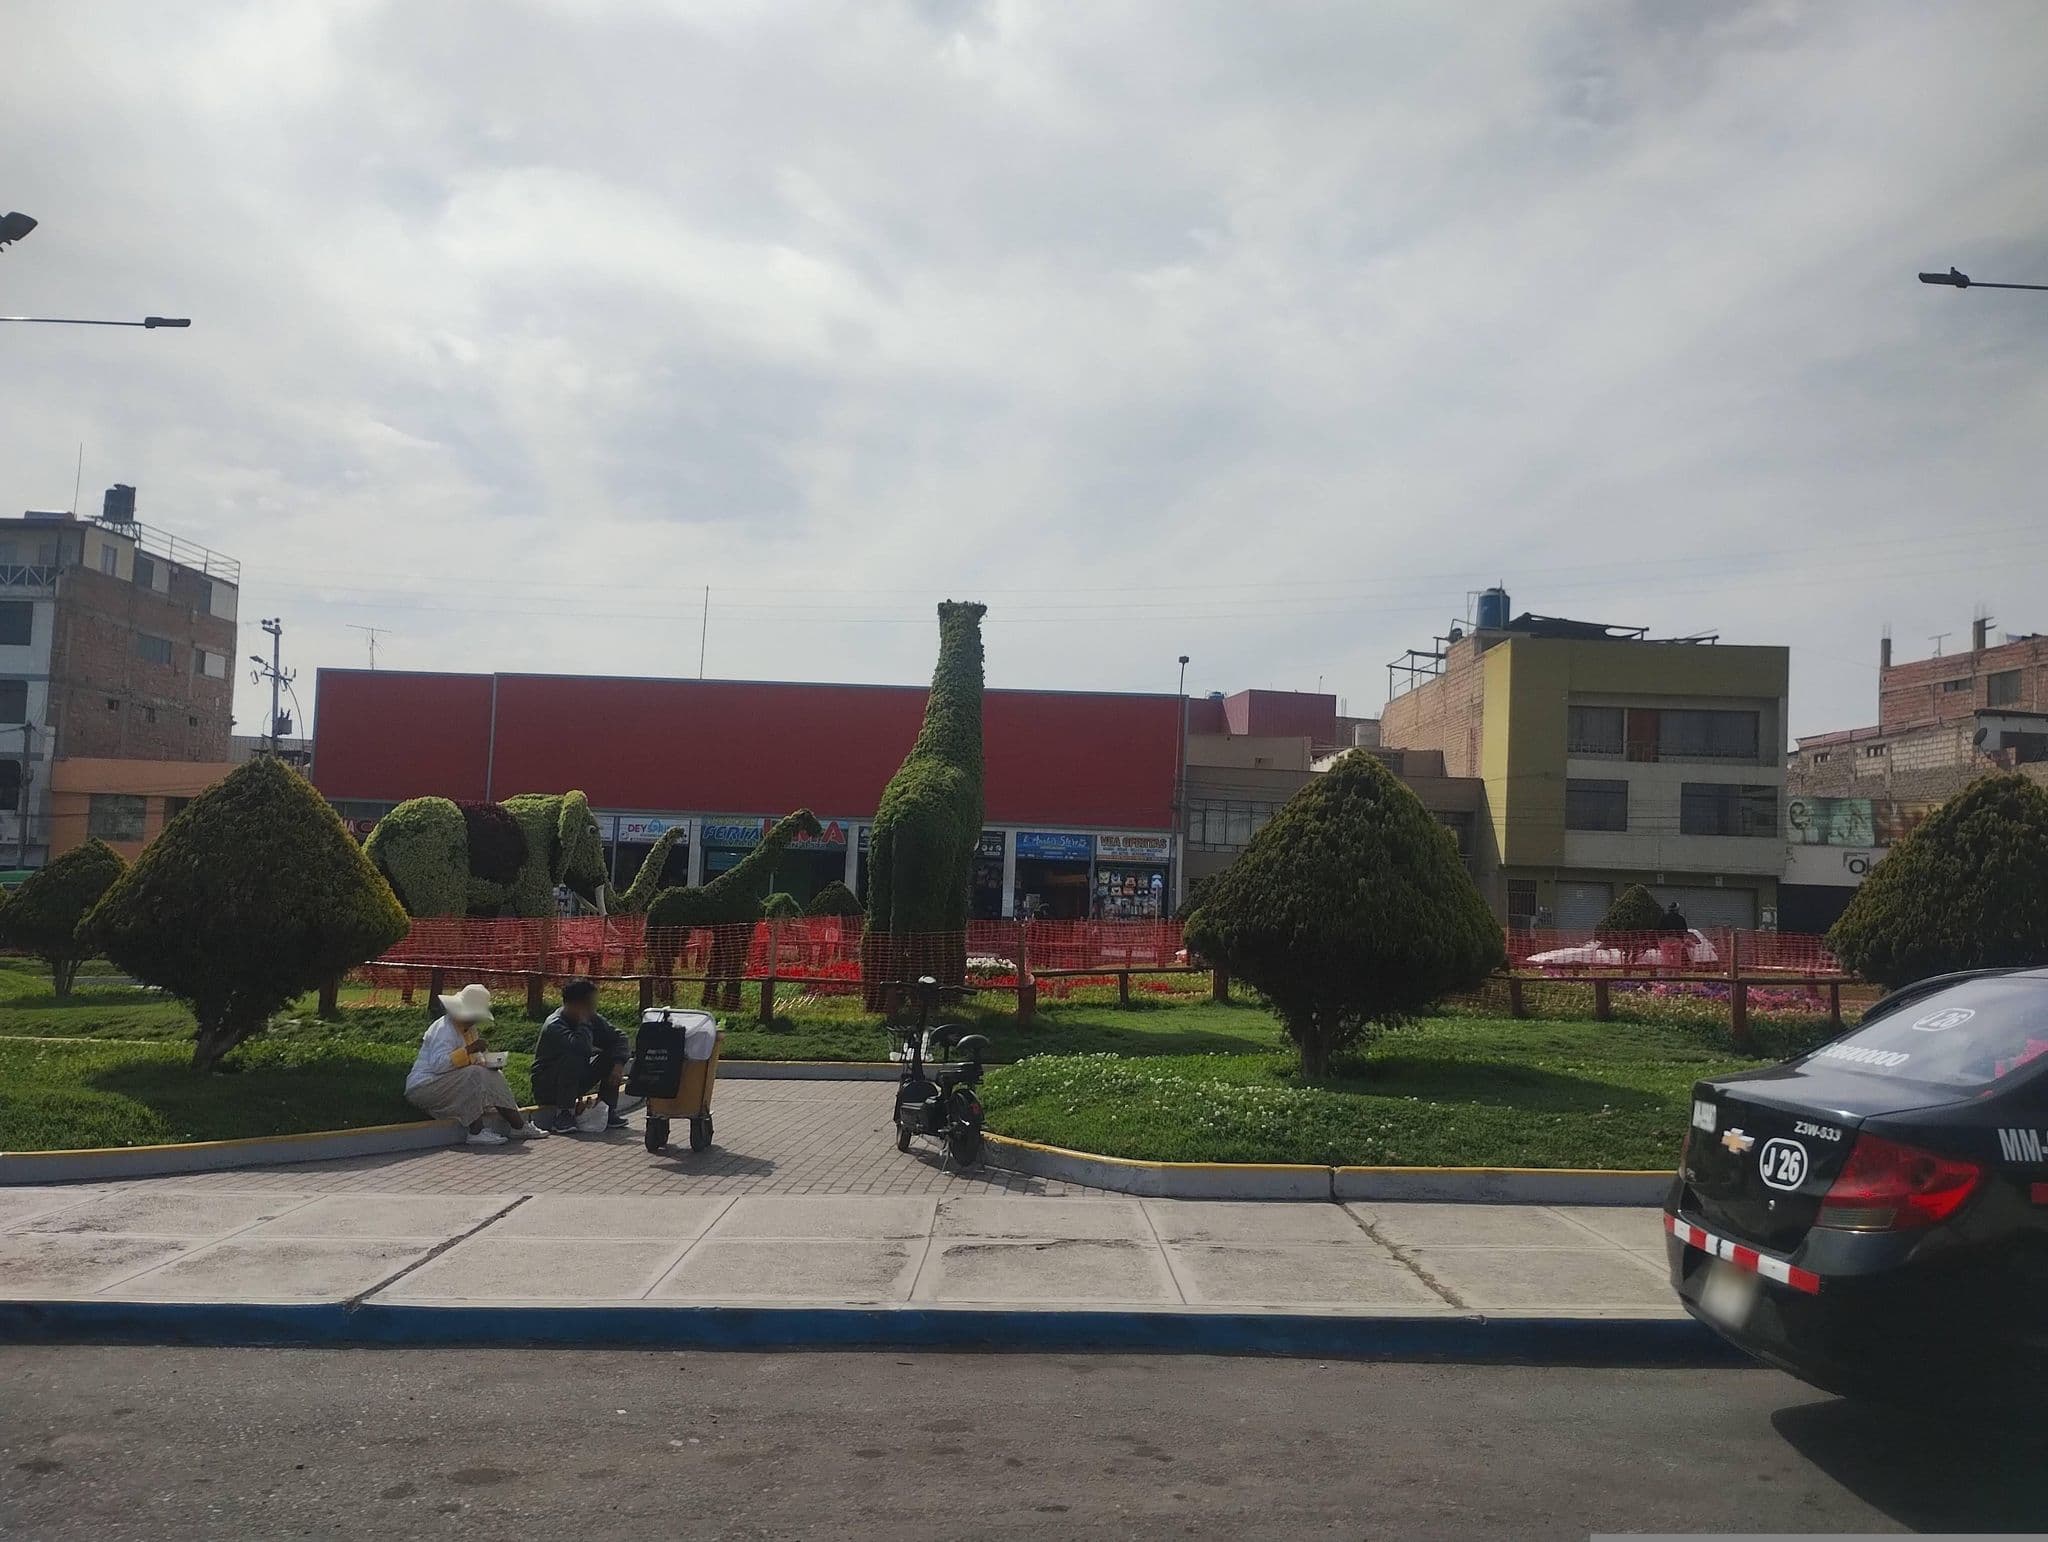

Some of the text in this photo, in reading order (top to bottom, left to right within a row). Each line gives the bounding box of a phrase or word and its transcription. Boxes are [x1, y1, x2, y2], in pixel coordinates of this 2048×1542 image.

[703, 825, 760, 842] FERIA
[1997, 1128, 2048, 1163] MM-
[1763, 1147, 1802, 1183] J 26
